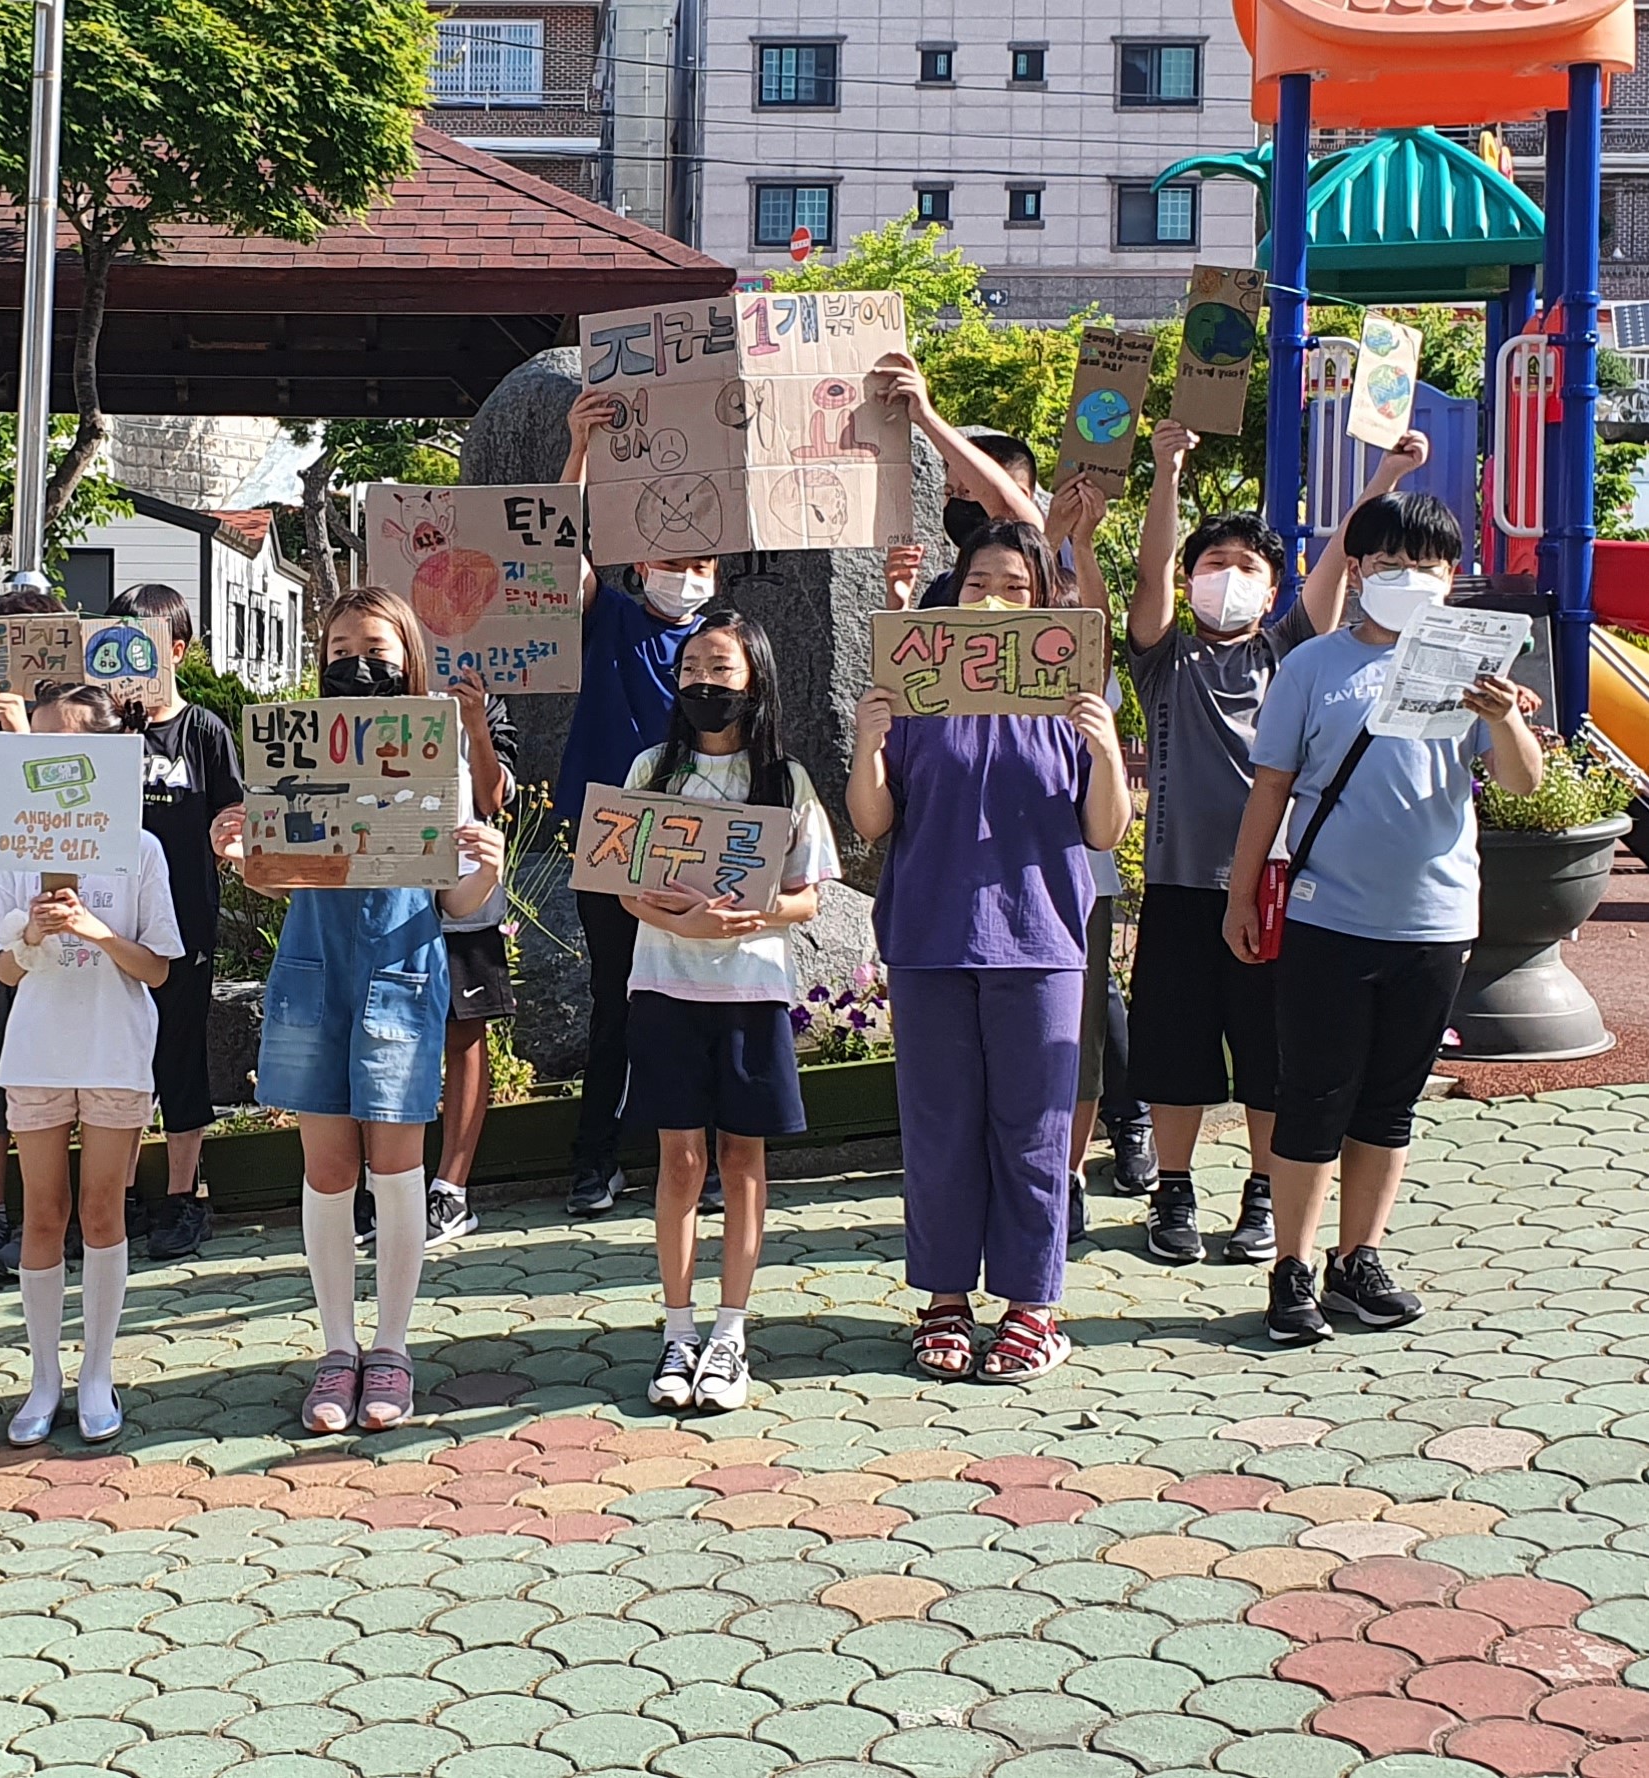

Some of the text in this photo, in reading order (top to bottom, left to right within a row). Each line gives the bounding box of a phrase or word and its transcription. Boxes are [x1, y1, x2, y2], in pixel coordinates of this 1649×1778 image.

[588, 305, 736, 385] 지구는
[503, 496, 578, 549] 탄소
[29, 627, 73, 649] 지구
[890, 621, 1082, 716] 살려요
[1323, 687, 1370, 706] SAVE
[251, 707, 320, 769] 발전
[374, 709, 448, 778] 환경
[14, 810, 111, 834] 생명에 대한
[586, 806, 766, 905] 지구를
